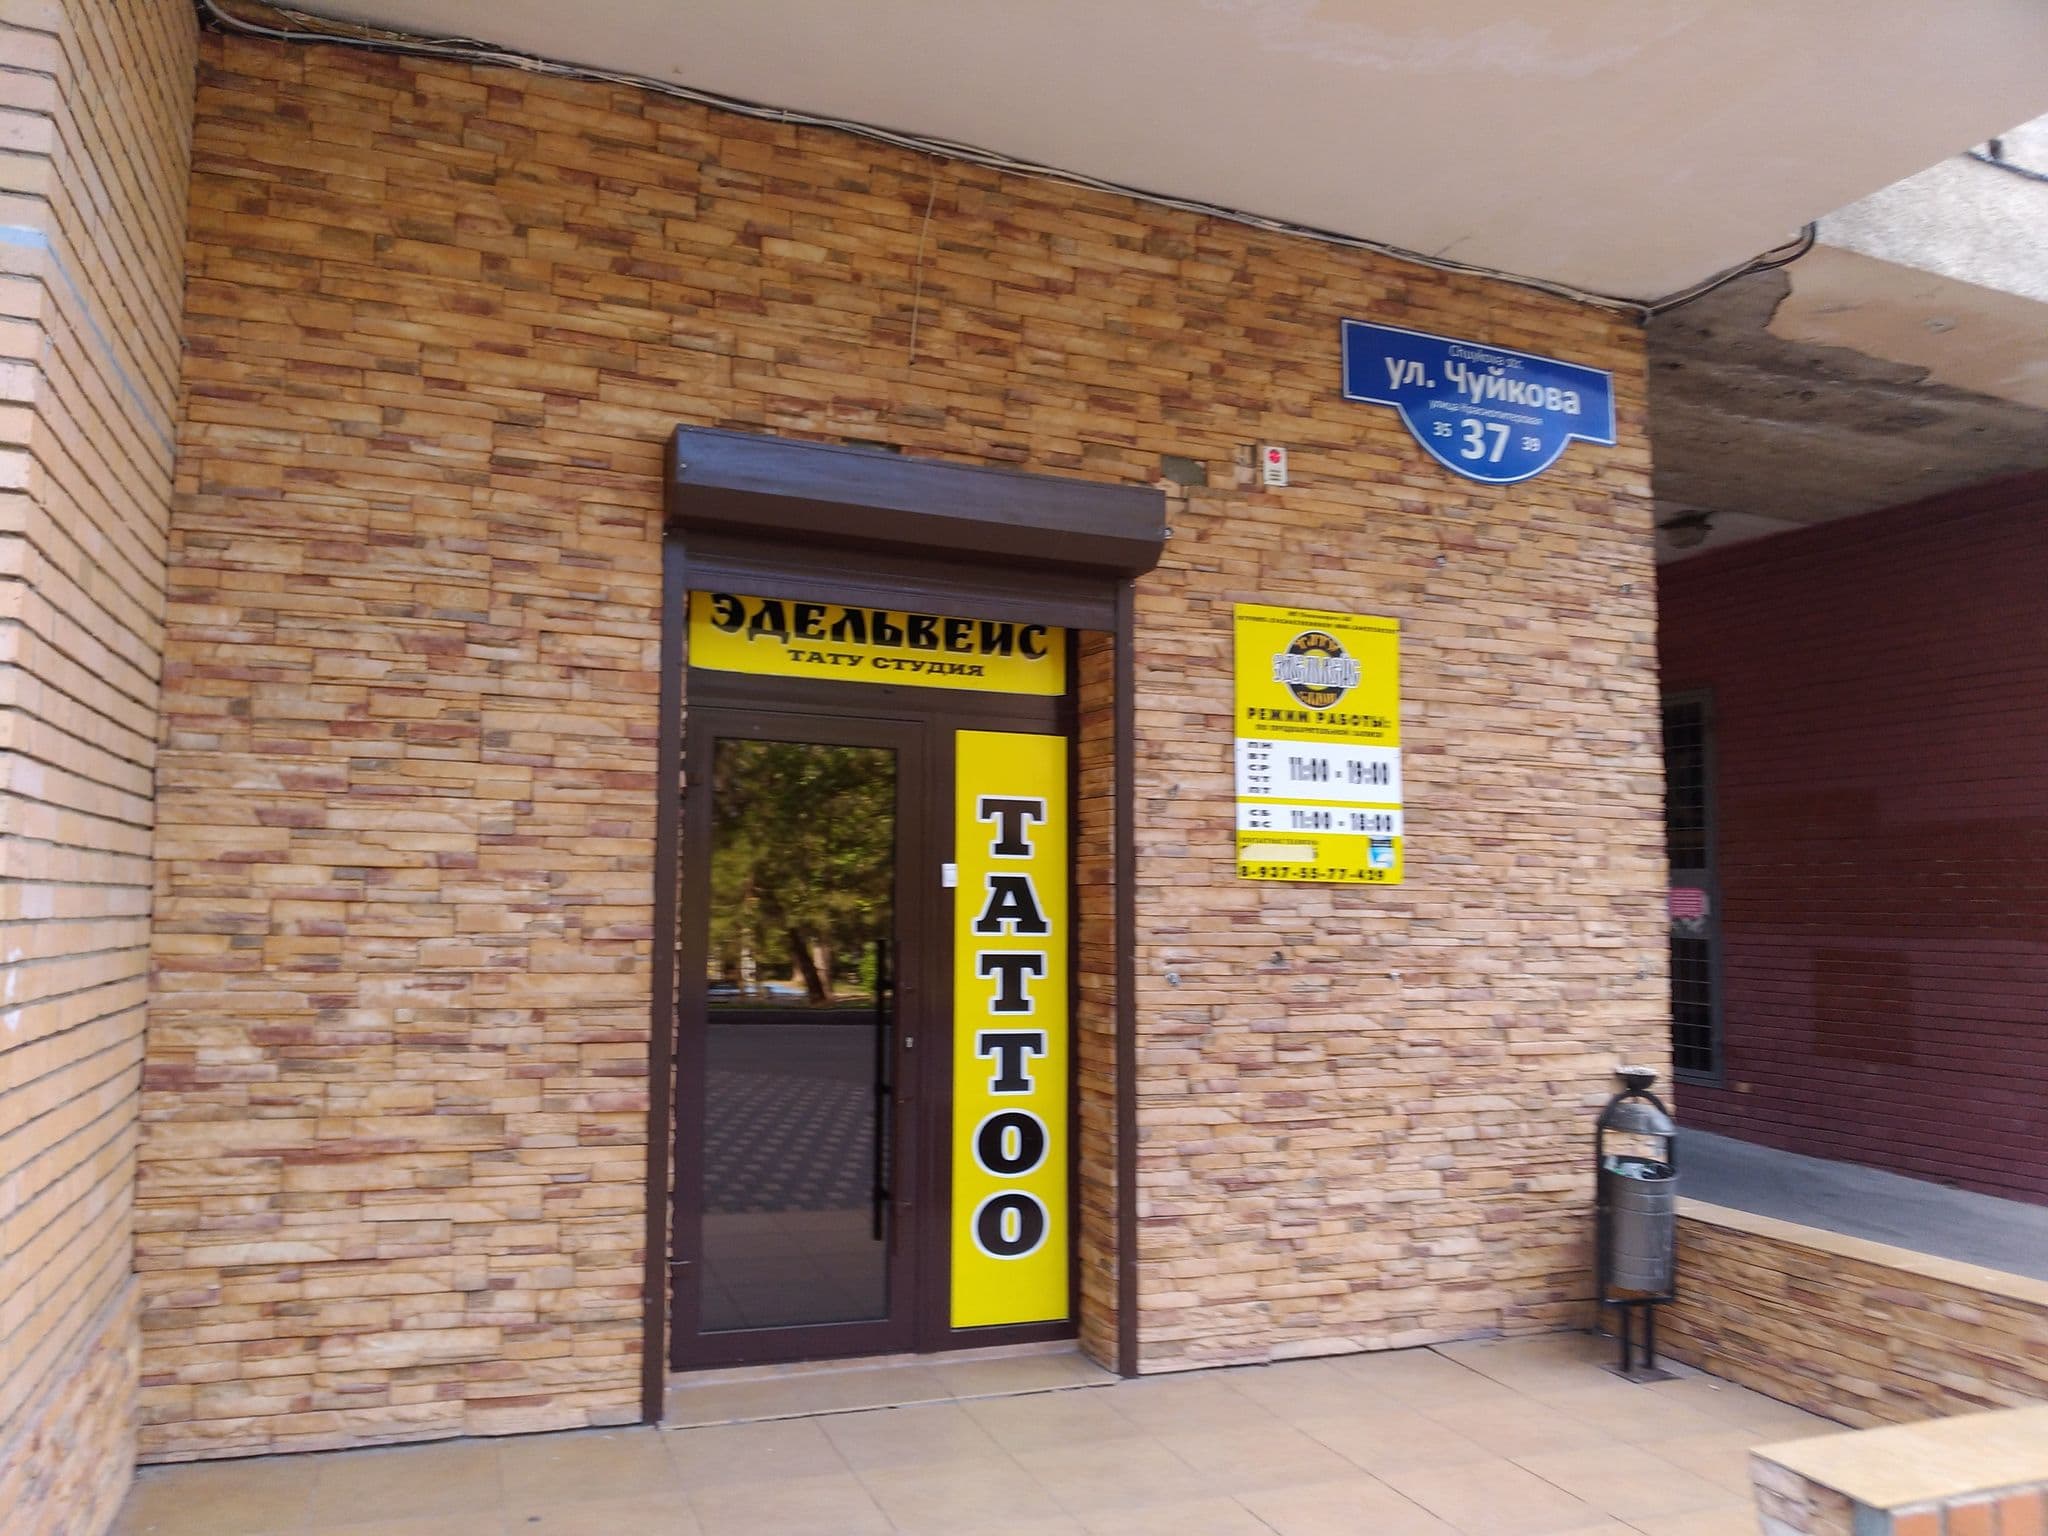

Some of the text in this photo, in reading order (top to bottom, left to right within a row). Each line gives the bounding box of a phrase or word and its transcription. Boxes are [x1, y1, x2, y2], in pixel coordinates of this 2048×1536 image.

[1384, 356, 1582, 416] ул. Чуйкова
[1459, 418, 1511, 463] 37
[787, 649, 985, 677] ТАТУ СТУДИЯ
[1248, 707, 1309, 724] РЕЖИМ
[1289, 757, 1330, 782] 11:00
[1291, 810, 1332, 830] 11:00
[972, 795, 1050, 1259] TATTOO
